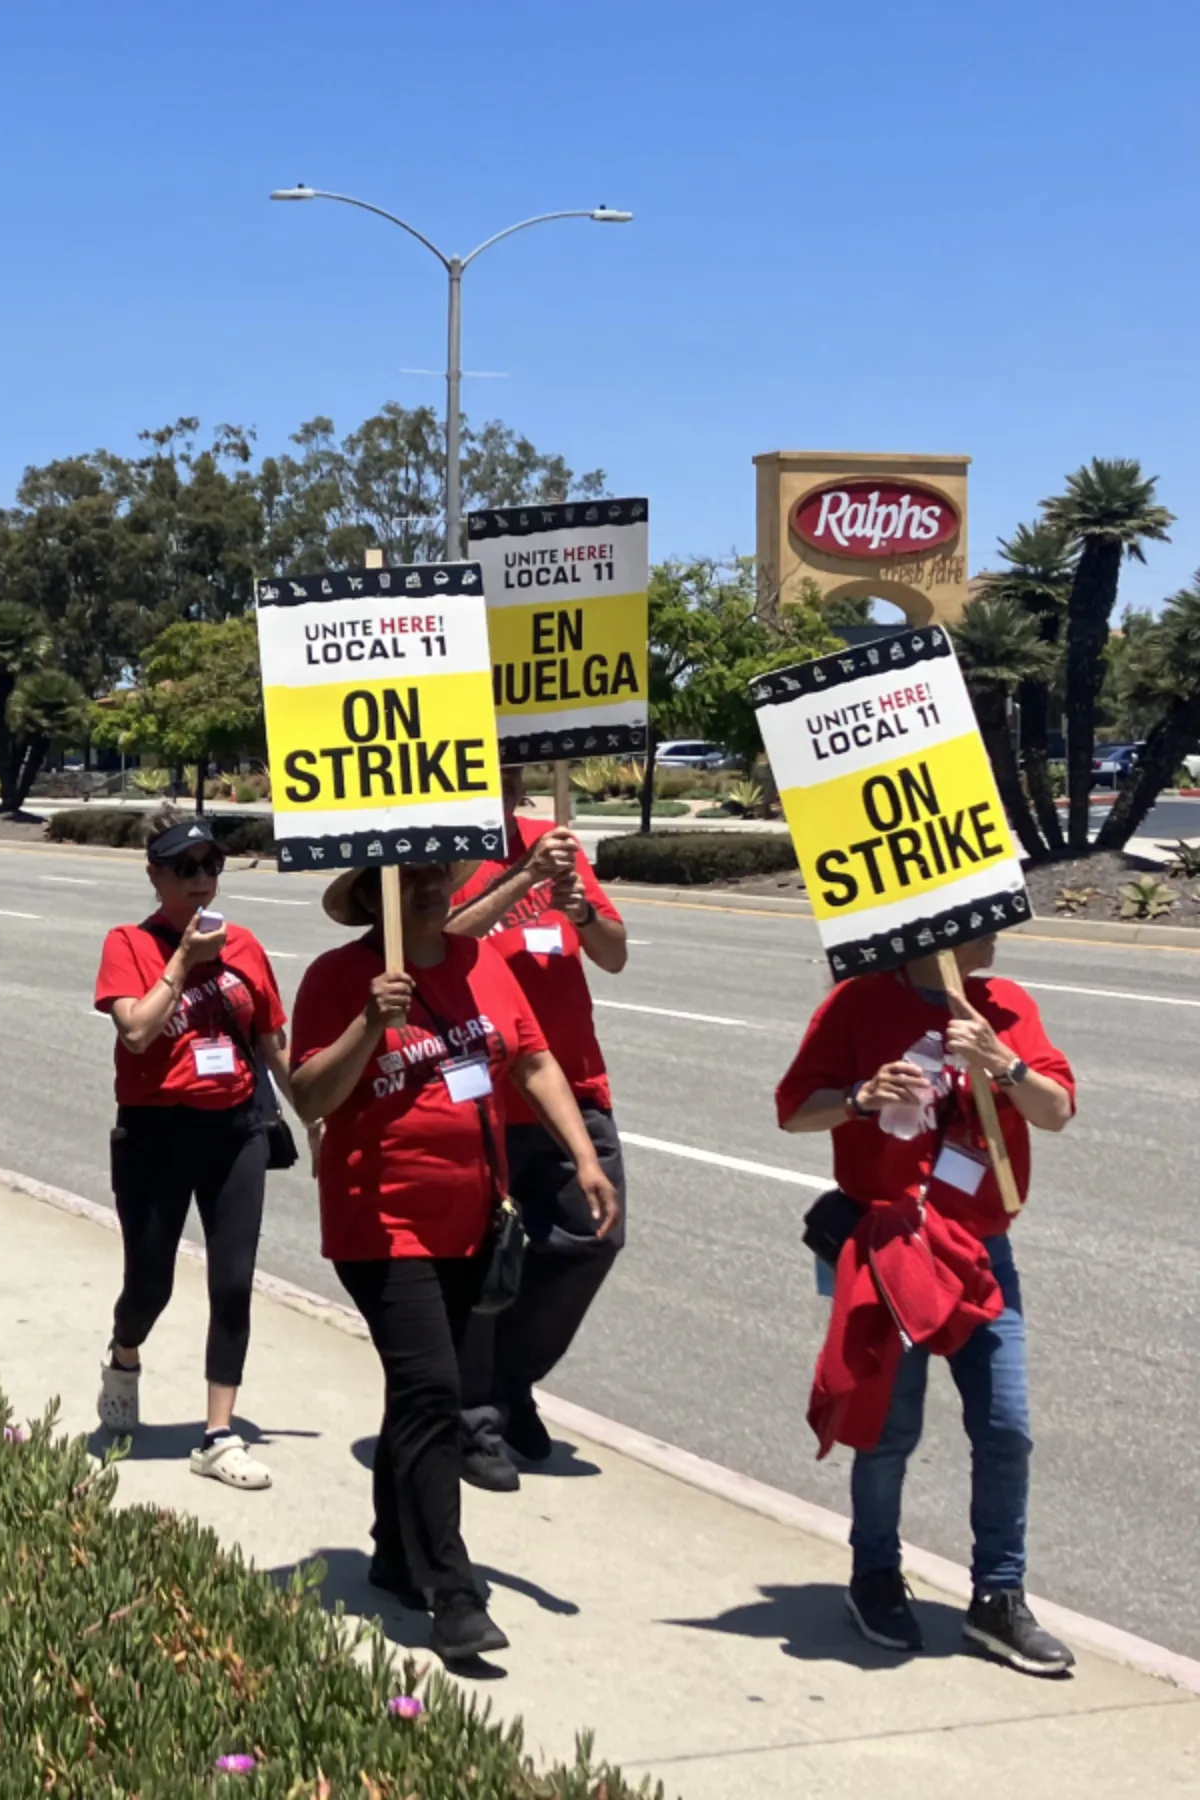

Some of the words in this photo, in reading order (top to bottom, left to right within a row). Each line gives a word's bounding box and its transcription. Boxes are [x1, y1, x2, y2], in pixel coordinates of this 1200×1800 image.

[813, 490, 941, 549] Ralphs
[504, 549, 559, 568] UNITE
[563, 544, 615, 561] HERE!
[504, 564, 581, 589] LOCAL
[594, 561, 615, 581] 11
[304, 619, 373, 641] UNITE
[380, 615, 445, 635] HERE!
[306, 638, 406, 665] LOCAL
[420, 635, 448, 658] 11
[532, 608, 583, 655] EN
[342, 687, 421, 744] ON
[806, 700, 876, 736] UNITE
[879, 681, 933, 713] HERE!
[811, 719, 909, 761] LOCAL
[918, 702, 941, 728] 11
[284, 739, 489, 803] STRIKE
[861, 761, 940, 833] ON
[815, 801, 1004, 908] STRIKE
